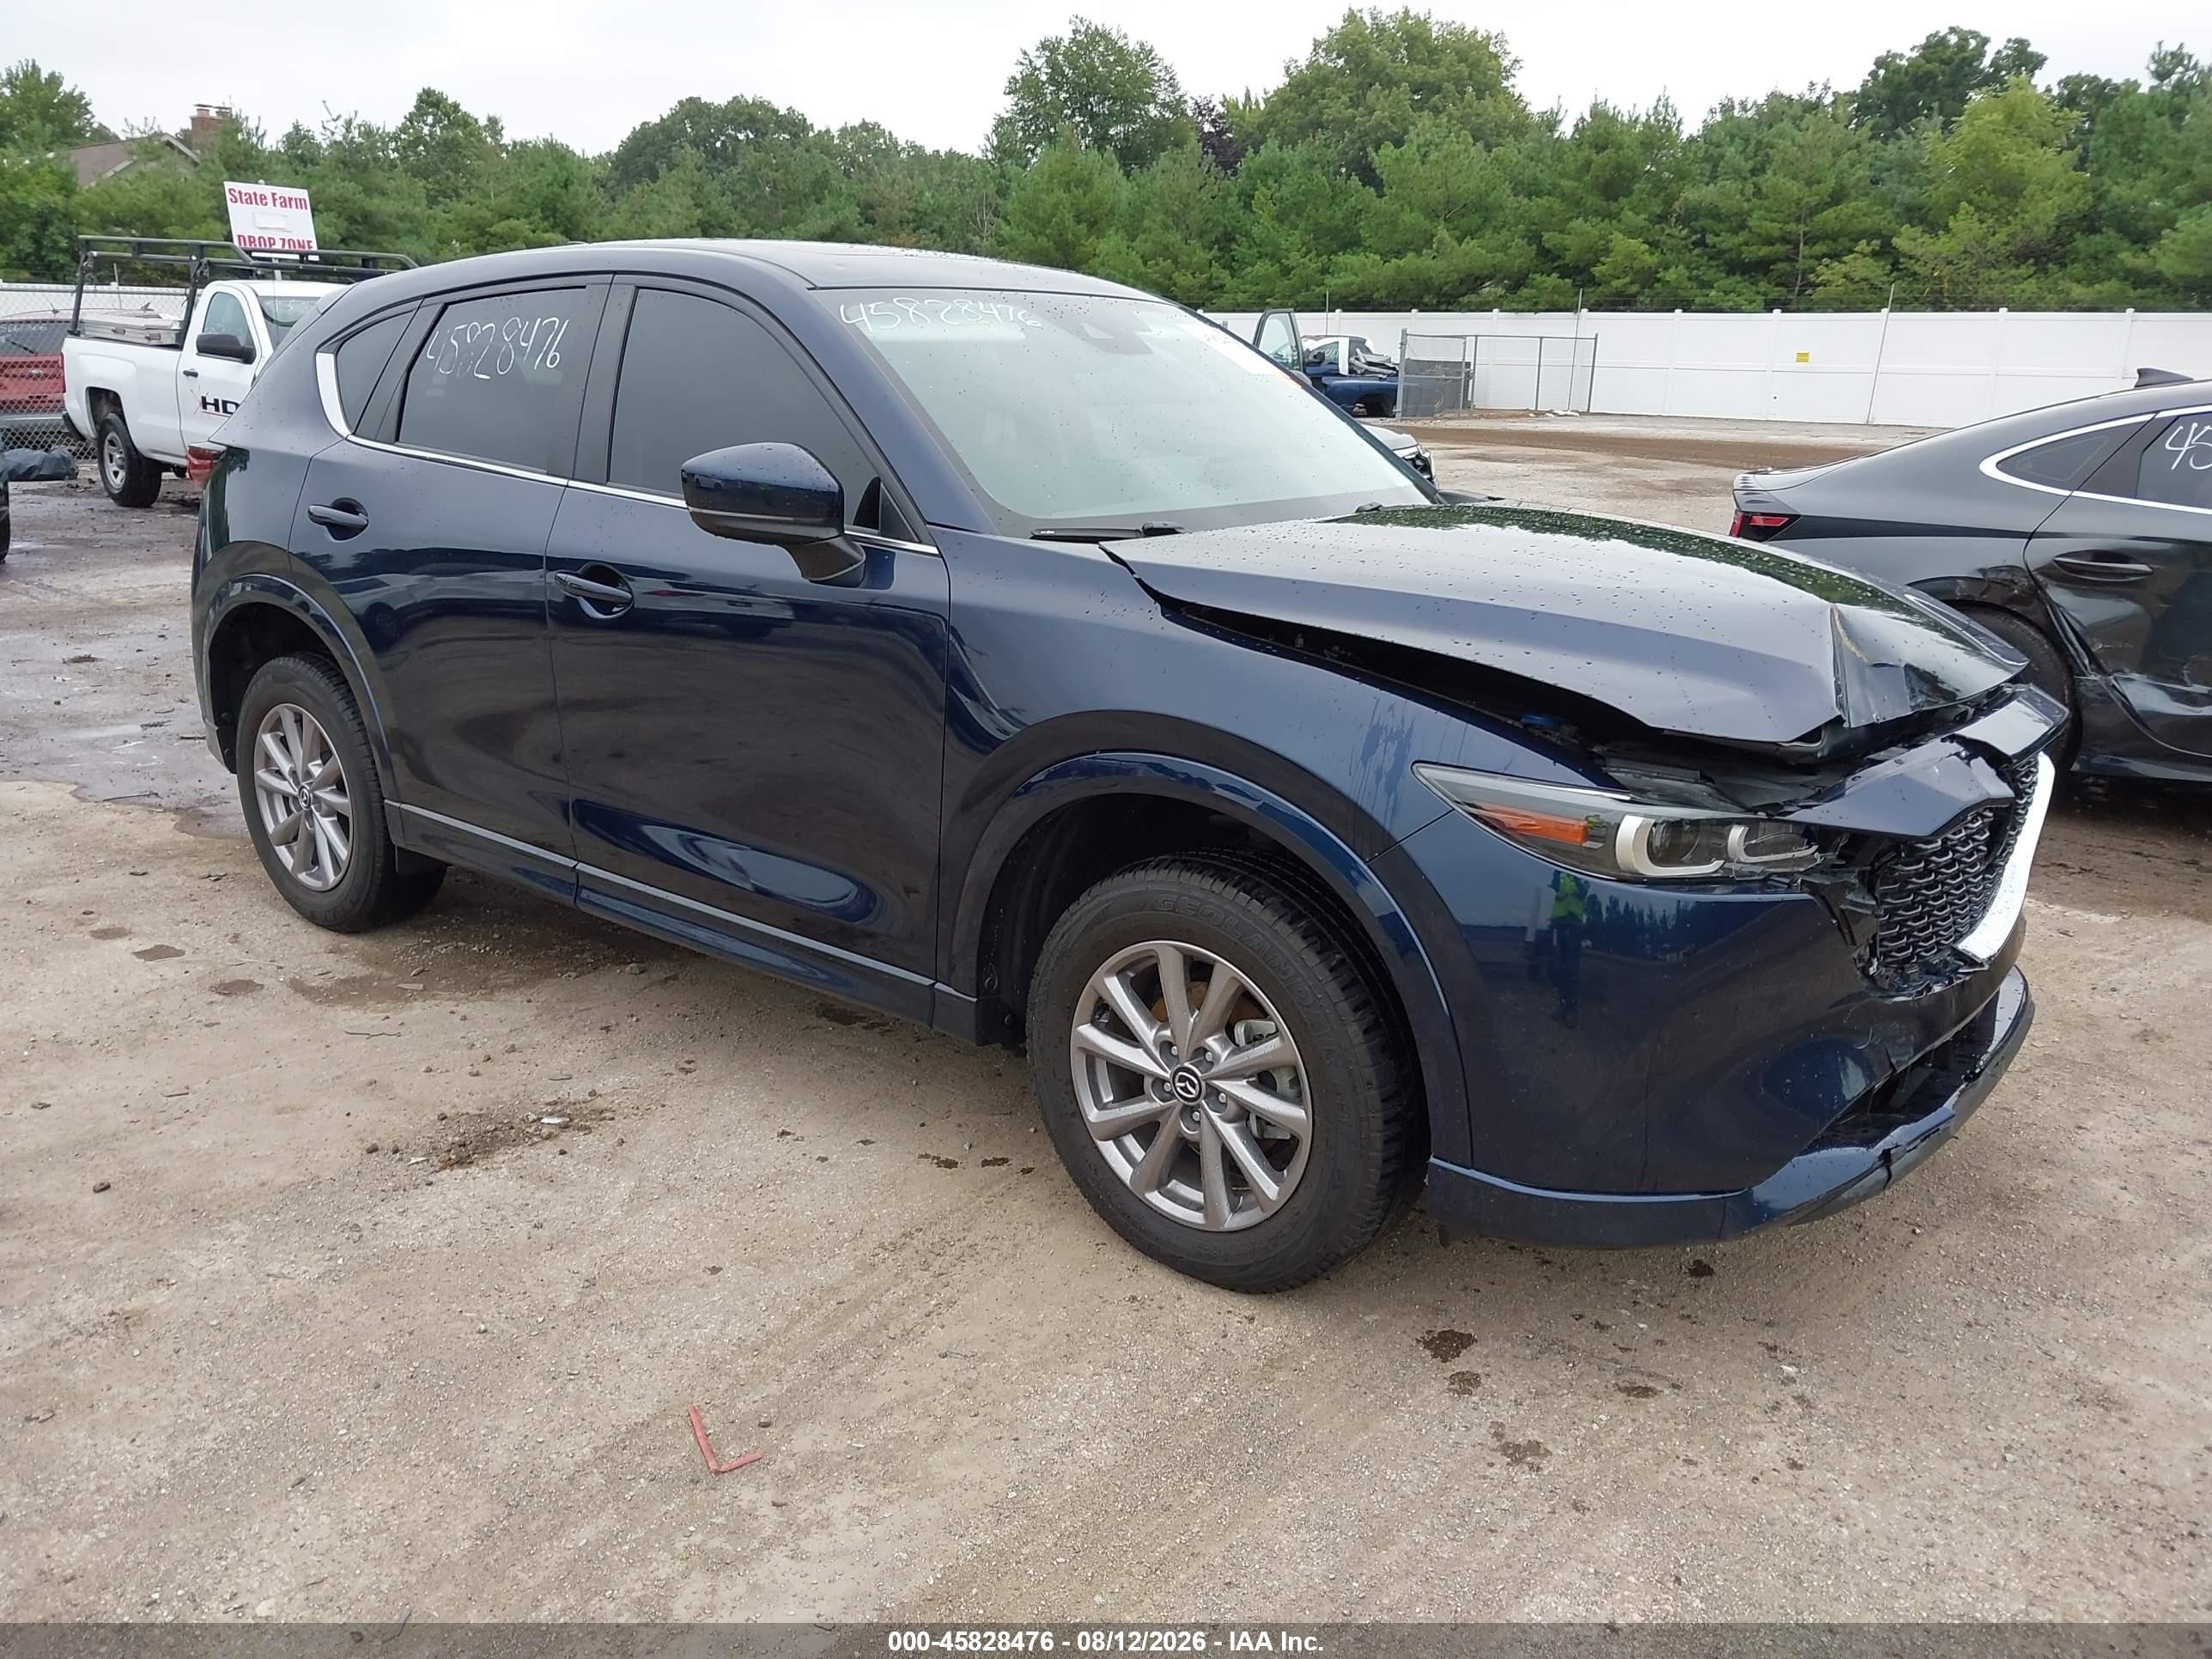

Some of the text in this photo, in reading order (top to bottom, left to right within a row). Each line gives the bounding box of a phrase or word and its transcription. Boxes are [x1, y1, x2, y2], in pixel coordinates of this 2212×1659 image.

[228, 188, 307, 210] State Farm
[237, 234, 276, 248] DROP
[840, 297, 1044, 332] 45828476
[201, 395, 240, 415] HD
